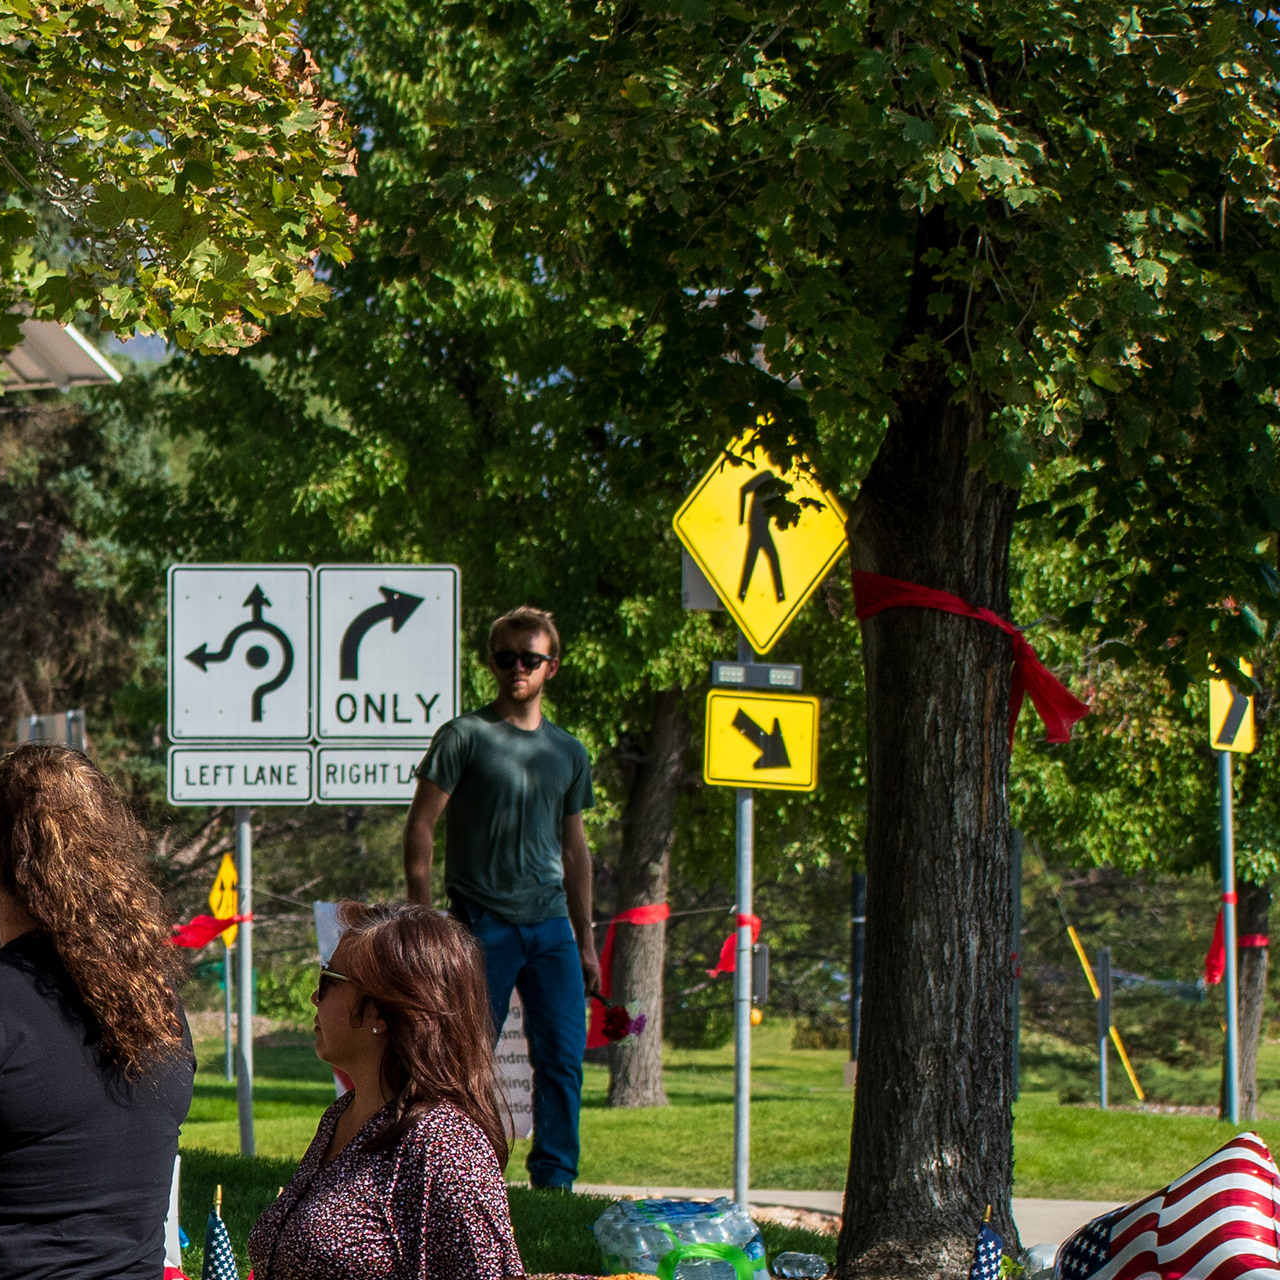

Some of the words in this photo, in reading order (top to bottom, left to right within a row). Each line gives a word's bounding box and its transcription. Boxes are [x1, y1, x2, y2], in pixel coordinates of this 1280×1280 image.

[335, 693, 440, 724] ONLY
[185, 764, 235, 786] LEFT
[244, 764, 297, 786] LANE
[325, 763, 389, 785] RIGHT
[397, 764, 418, 784] LA
